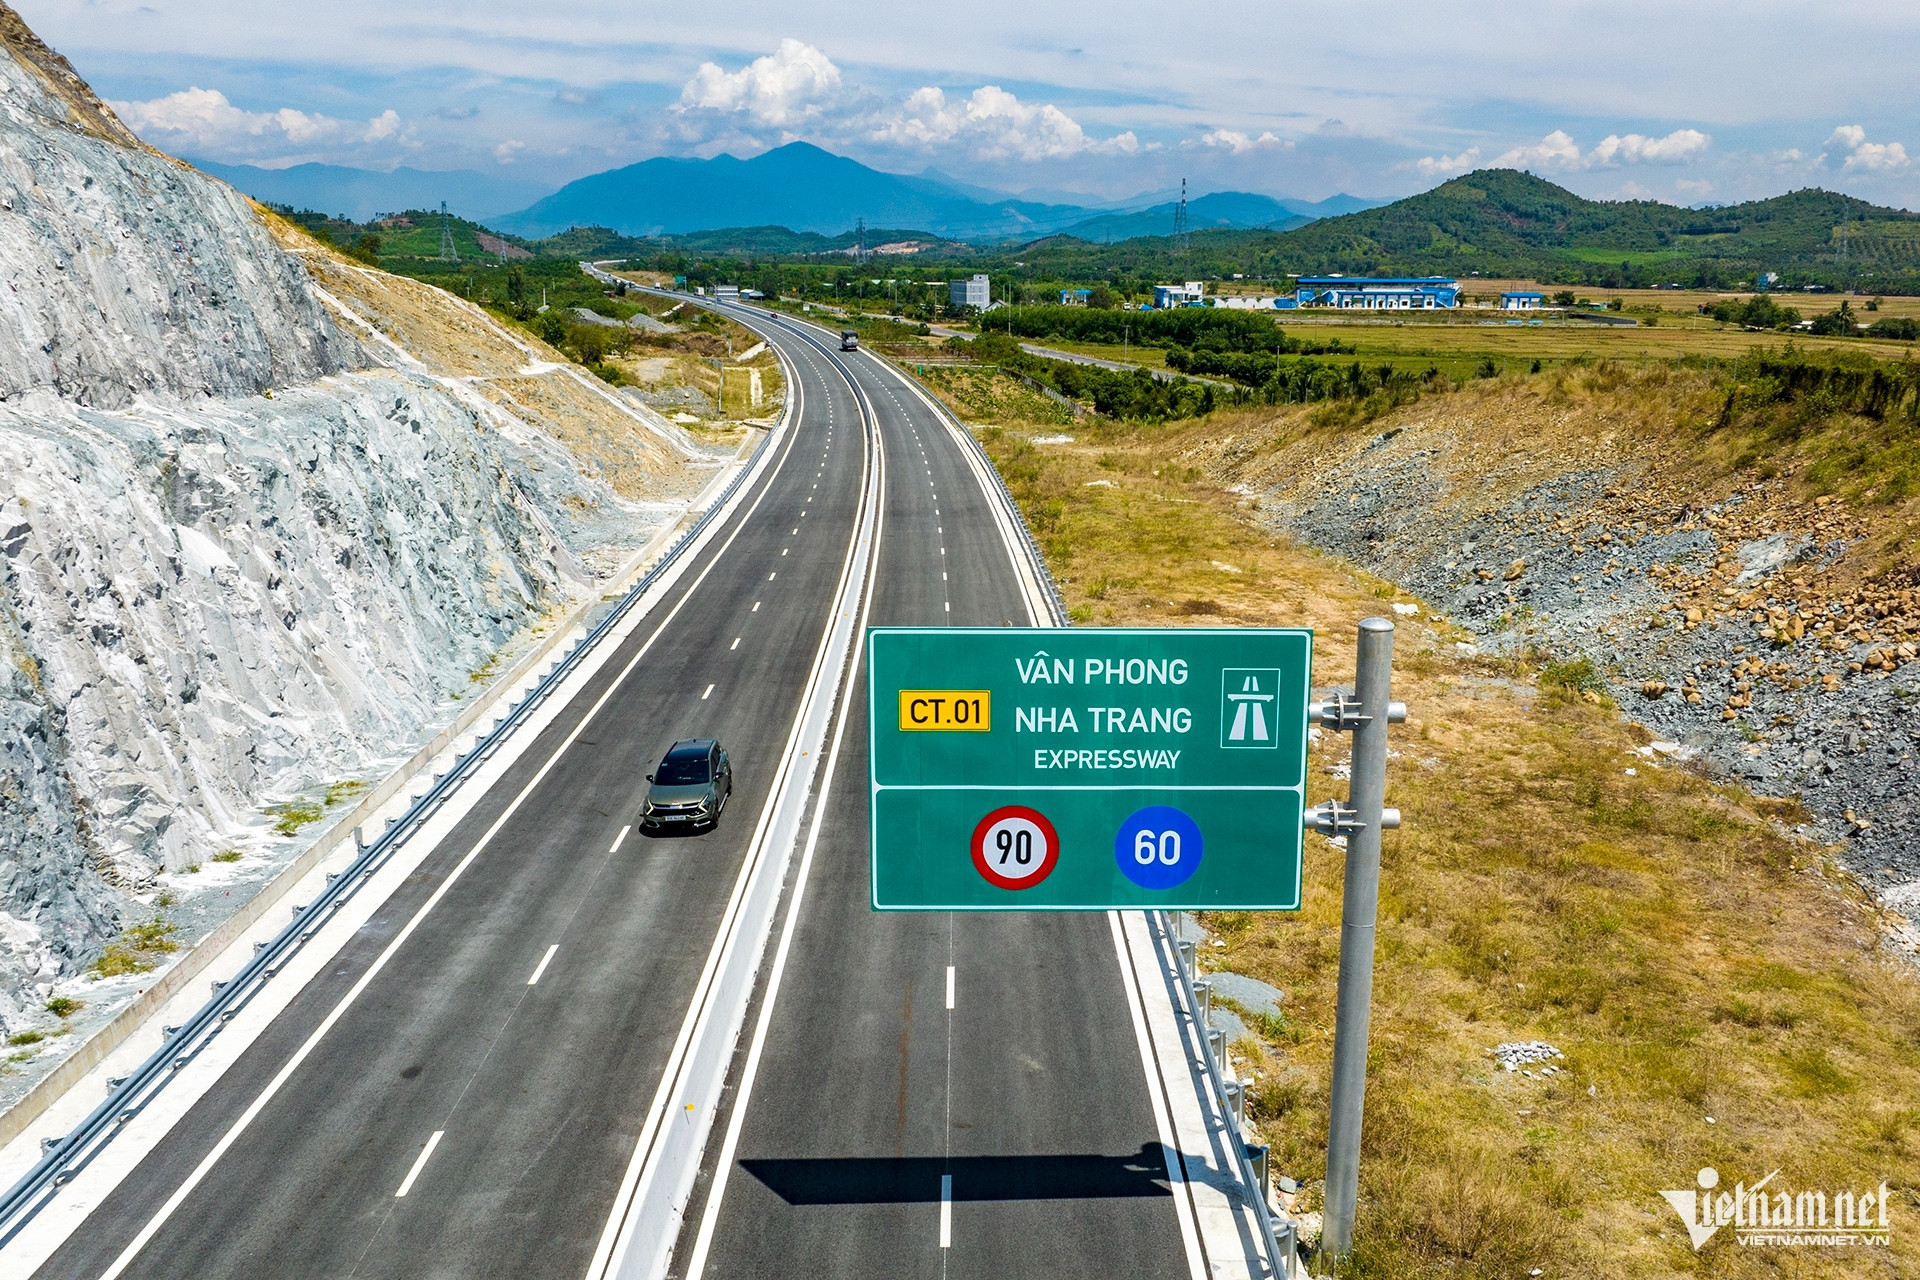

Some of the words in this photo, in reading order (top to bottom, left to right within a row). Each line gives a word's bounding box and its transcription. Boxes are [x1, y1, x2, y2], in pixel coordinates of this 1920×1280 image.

[1016, 650, 1074, 684] VÂN
[1086, 658, 1188, 685] PHONG
[910, 699, 980, 724] CT.01
[1015, 707, 1079, 733] NHA
[1087, 707, 1192, 733] TRANG
[1034, 749, 1181, 769] EXPRESSWAY
[996, 829, 1032, 865] 90
[1134, 829, 1181, 866] 60
